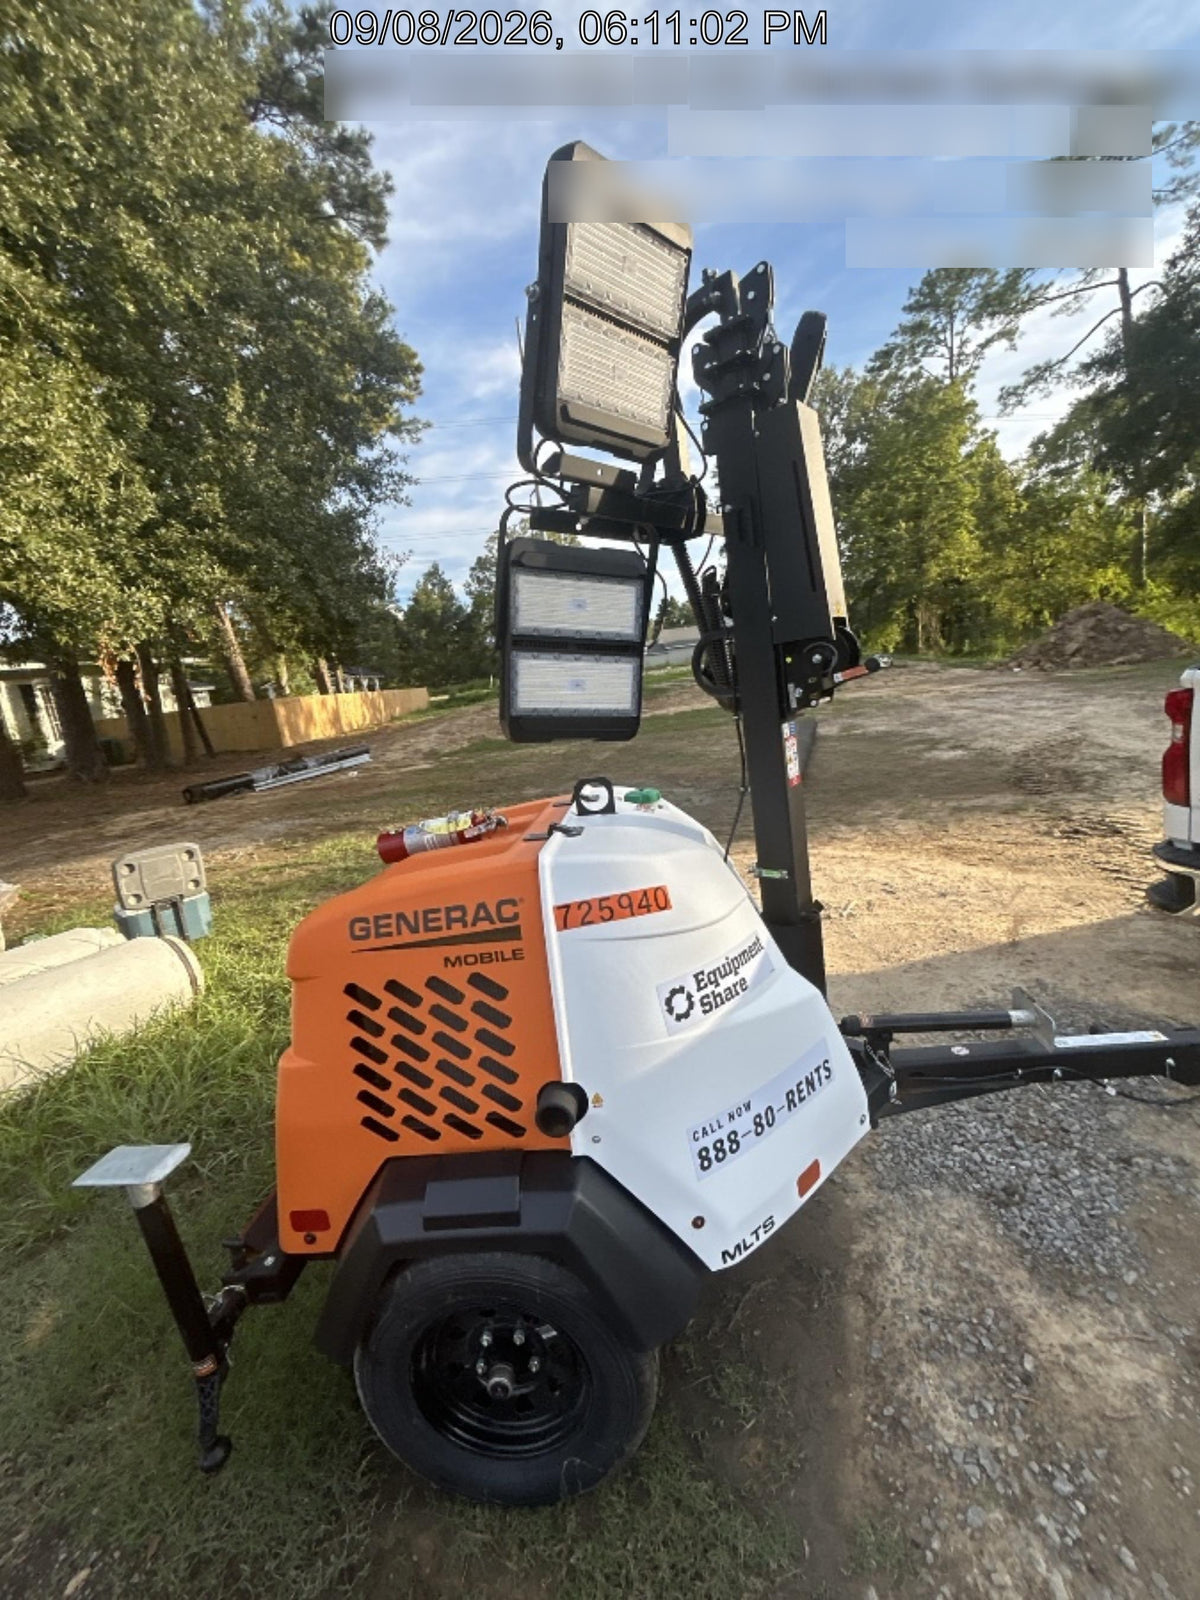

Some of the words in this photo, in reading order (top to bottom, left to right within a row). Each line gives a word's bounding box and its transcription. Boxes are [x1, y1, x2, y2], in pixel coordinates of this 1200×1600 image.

[349, 898, 520, 941] GENERAC
[555, 886, 669, 929] 725940
[443, 949, 525, 968] MOBILE
[693, 936, 764, 993] Equipment
[699, 976, 749, 1016] Share
[692, 1120, 724, 1143] CALL
[727, 1099, 752, 1122] NOW
[697, 1058, 833, 1172] 888-80-RENTS
[720, 1215, 776, 1264] MLTS
